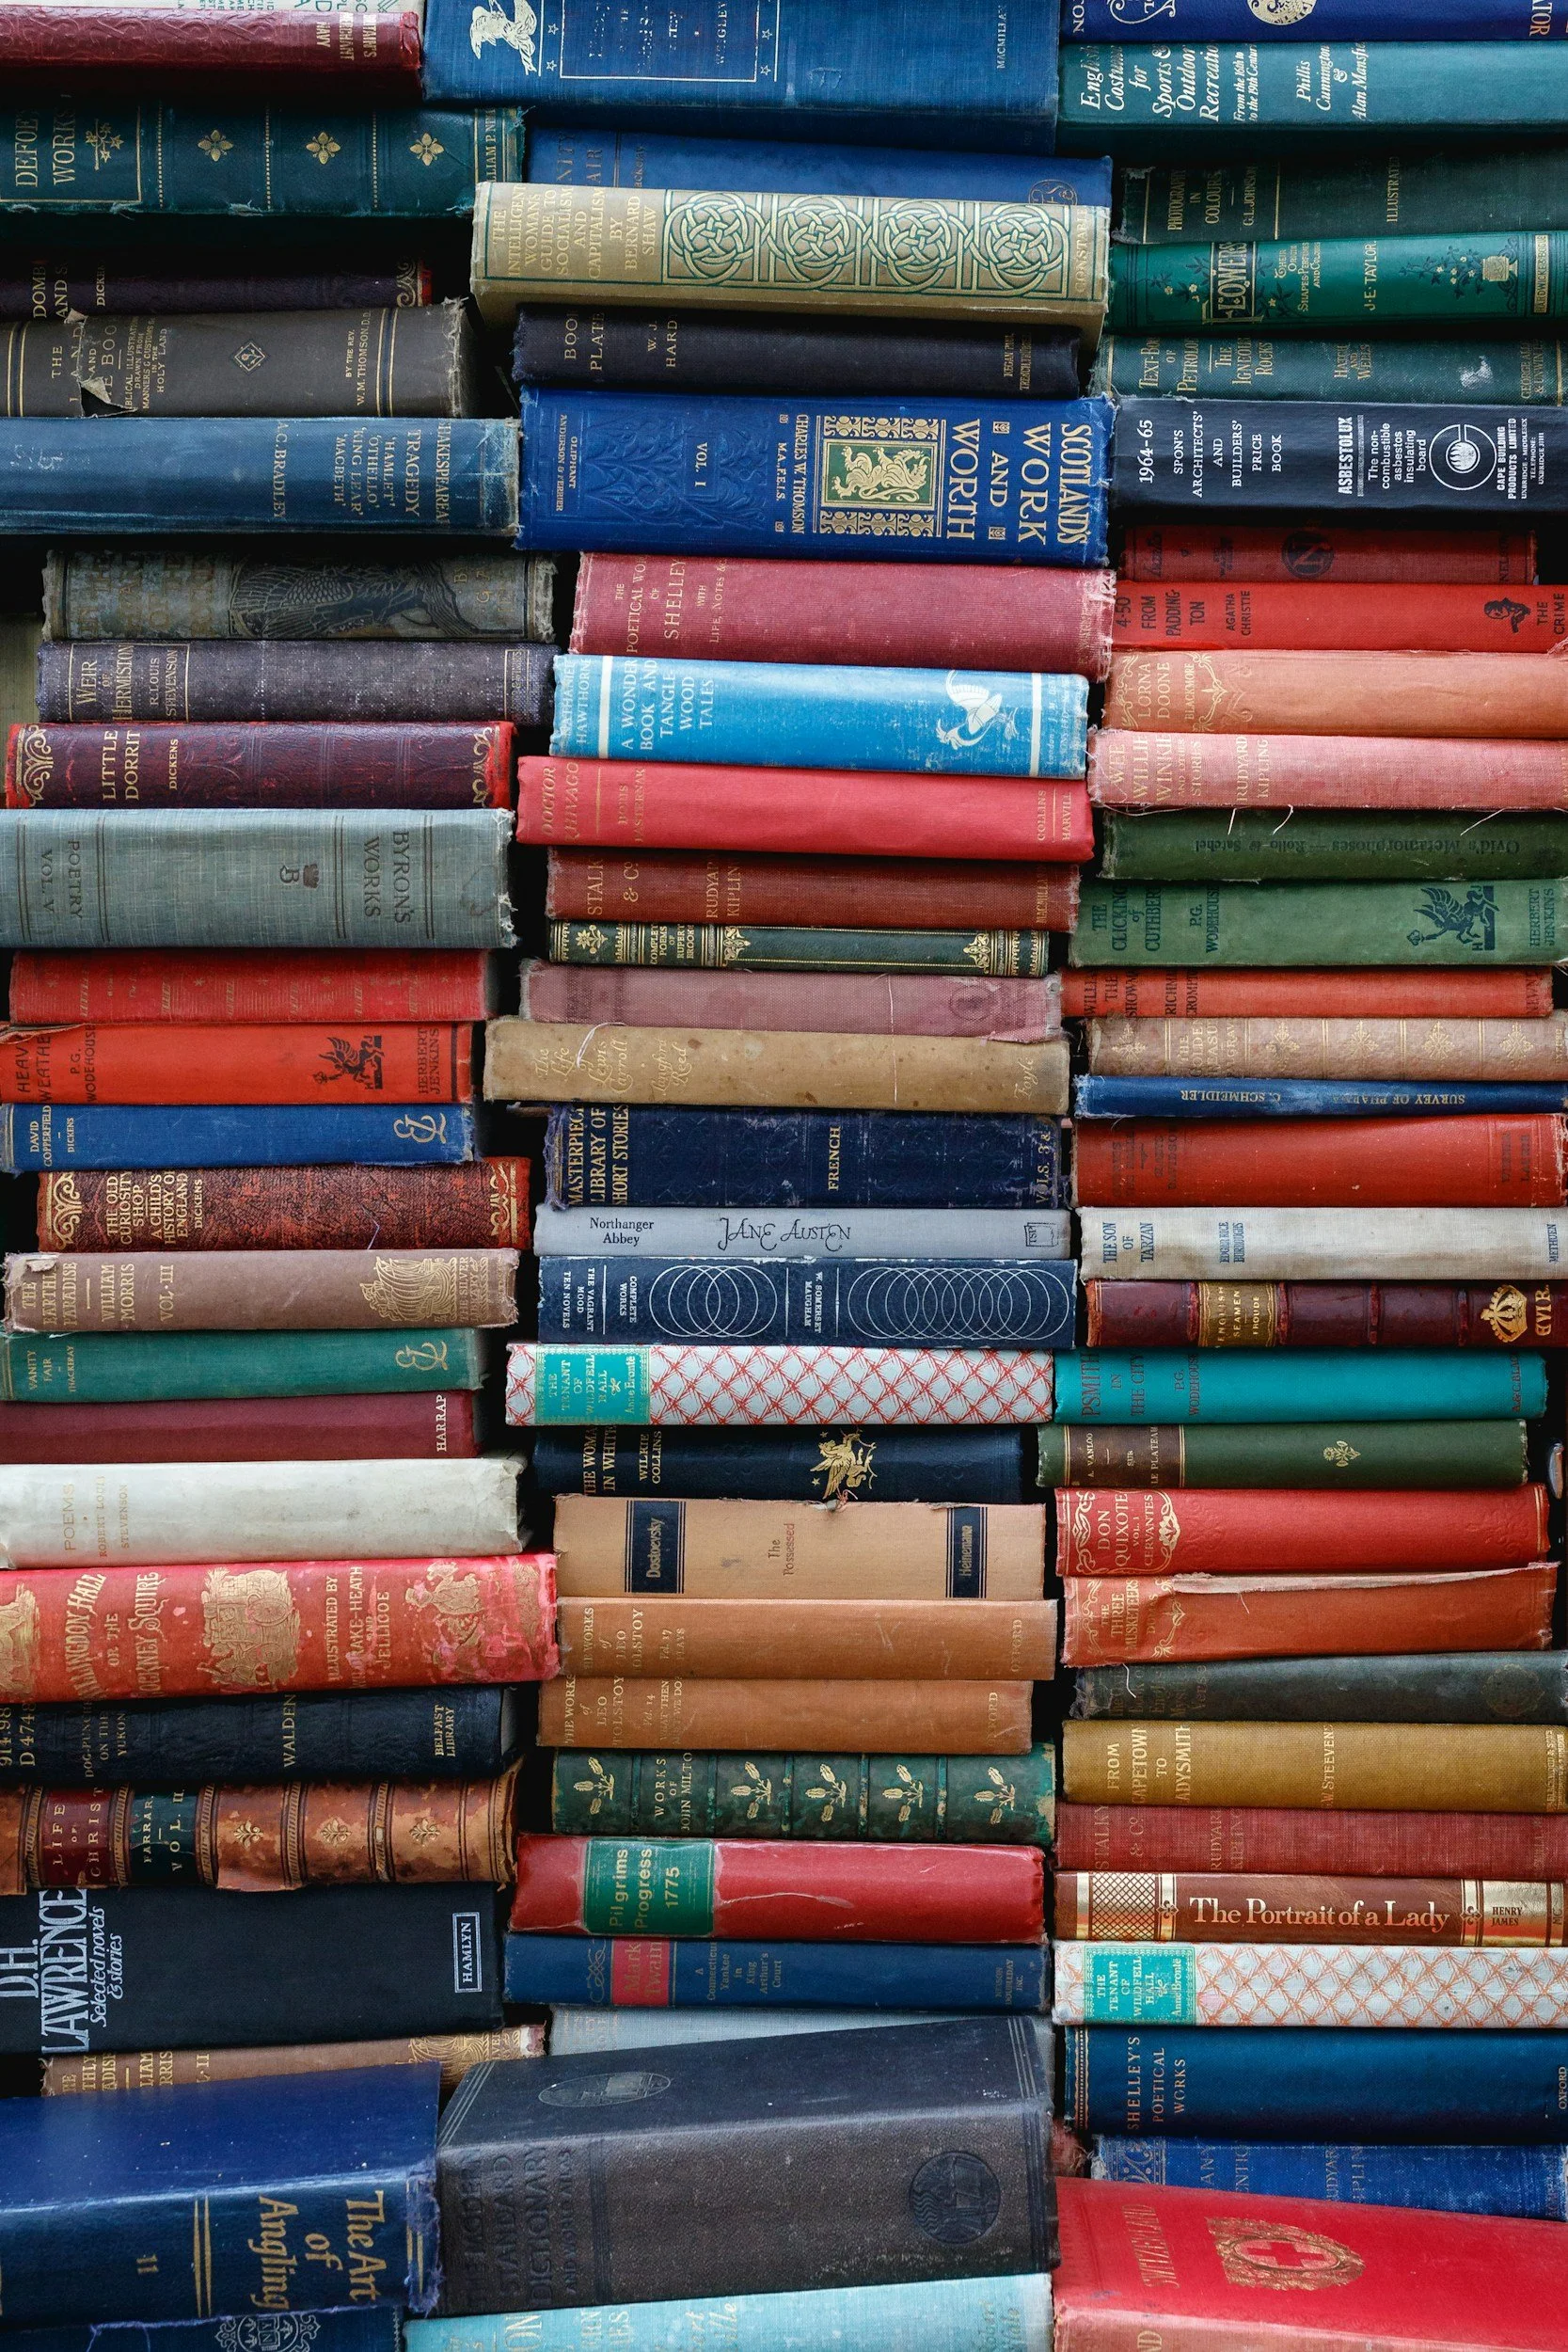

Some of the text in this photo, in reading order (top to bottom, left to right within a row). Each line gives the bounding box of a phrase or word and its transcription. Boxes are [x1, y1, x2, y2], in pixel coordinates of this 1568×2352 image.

[1130, 65, 1150, 90] for
[1153, 46, 1177, 118] Sports &
[1177, 46, 1199, 111] Outdoor
[1295, 60, 1313, 102] Phillis
[492, 210, 506, 245] THE
[541, 190, 557, 271] GUIDE TO
[574, 211, 587, 248] AND
[610, 217, 624, 240] BY
[626, 196, 641, 270] BERNARD
[641, 204, 657, 255] SHAW
[52, 345, 63, 378] THE
[157, 328, 167, 392] HOLY LAND
[347, 329, 356, 347] REV.
[1215, 347, 1233, 368] THE
[1256, 342, 1274, 375] ROCKS
[1335, 345, 1351, 378] HATCH
[1358, 344, 1372, 379] WELLS
[346, 368, 354, 377] BY
[404, 430, 420, 516] TRAGEDY
[569, 437, 578, 488] OLIPHANT
[792, 414, 809, 533] CHARLES W. THOMSON
[990, 451, 1008, 507] AND
[1138, 420, 1153, 484] 1964-65
[1173, 430, 1183, 474] SPON'S
[1193, 410, 1203, 498] ARCHITECTS'
[1212, 438, 1224, 468] AND
[1232, 420, 1243, 487] BUILDERS'
[1252, 434, 1263, 471] PRICE
[1272, 434, 1283, 472] BOOK
[1338, 417, 1354, 495] ASBESTOLUX
[1370, 430, 1381, 481] The non-
[1380, 422, 1391, 489] combustible
[1392, 431, 1403, 481] asbestos
[1404, 430, 1417, 484] insulating
[1417, 439, 1428, 471] board
[1497, 426, 1507, 490] CAPE BUILDING
[1508, 418, 1518, 499] PRODUCTS LIMITED
[946, 419, 980, 540] WORTH
[1018, 422, 1050, 545] WORK
[1056, 423, 1092, 544] SCOTLAND'S
[665, 557, 687, 640] SHELLEY
[1141, 596, 1157, 629] FROM
[1190, 601, 1206, 626] TON
[1226, 593, 1236, 631] AGATHA
[1240, 591, 1251, 636] CHRISTIE
[1536, 601, 1548, 627] THE
[1551, 593, 1565, 635] CRIME
[76, 660, 97, 704] WEIR
[102, 674, 111, 687] OF
[165, 649, 179, 717] STEVENSON
[621, 659, 638, 750] A WONDER
[640, 660, 657, 750] BOOK AND
[660, 669, 675, 739] TANGLE-
[680, 676, 696, 730] WOOD
[700, 679, 715, 730] TALES
[1137, 662, 1151, 718] LORNA
[1156, 662, 1171, 719] DOONE
[1184, 662, 1196, 721] BLACKMORE
[102, 730, 119, 801] LITTLE
[124, 729, 141, 801] DORRIT
[168, 739, 180, 789] DICKENS
[1234, 735, 1250, 802] RUDYARD
[1256, 739, 1271, 798] KIPLING
[541, 767, 557, 835] DOCTOR
[1037, 789, 1047, 842] COLLINS
[1061, 792, 1072, 841] HARVILL
[40, 850, 54, 913] VOL. V
[68, 840, 83, 919] POETRY
[364, 835, 381, 918] WORKS
[392, 831, 414, 924] BYRON'S
[29, 1120, 40, 1152] DAVID
[42, 1105, 54, 1167] COPPERFIELD
[67, 1117, 76, 1152] DICKENS
[591, 1108, 607, 1203] LIBRARY OF
[828, 1125, 842, 1190] FRENCH
[106, 1175, 119, 1236] THE OLD
[133, 1184, 145, 1227] SHOP
[149, 1174, 163, 1239] A CHILD'S
[176, 1173, 189, 1238] ENGLAND
[193, 1179, 203, 1229] DICKENS
[590, 1221, 655, 1231] Northanger
[603, 1235, 641, 1246] Abbey
[1102, 1222, 1117, 1263] THE SON
[1122, 1236, 1133, 1249] OF
[1140, 1222, 1154, 1263] TARZAN
[1546, 1223, 1560, 1263] METHUEN
[101, 1264, 117, 1322] WILLIAM
[119, 1263, 135, 1321] MORRIS
[1232, 1290, 1242, 1338] SEAMEN
[27, 1351, 38, 1391] VANITY
[43, 1358, 53, 1382] FAIR
[436, 1394, 448, 1452] HARRAP
[1085, 1433, 1094, 1466] VANLOO
[639, 1434, 650, 1481] WILKIE
[651, 1430, 663, 1484] COLLINS
[645, 1517, 663, 1578] Dostoevsky
[768, 1539, 781, 1559] The
[782, 1522, 795, 1576] Possessed
[958, 1525, 974, 1577] Heinemann
[1096, 1510, 1112, 1551] DON
[1113, 1493, 1130, 1567] QUIXOTE
[1143, 1494, 1155, 1566] CERVANTES
[325, 1575, 340, 1681] ILLUSTRATED BY
[375, 1591, 390, 1669] JELLICOE
[1110, 1593, 1126, 1638] THREE
[283, 1693, 297, 1768] WALDEN
[435, 1705, 445, 1756] BELFAST
[445, 1708, 456, 1756] LIBRARY
[609, 1849, 629, 1928] Pilgrims
[634, 1848, 654, 1929] Progress
[664, 1867, 680, 1908] 1775
[1189, 1897, 1450, 1932] The Portrait of a Lady
[1492, 1906, 1523, 1916] HENRY
[1492, 1917, 1519, 1927] JAMES
[39, 1888, 89, 2053] LAWRENCE
[89, 1906, 107, 2027] Selected novels
[106, 1932, 123, 2000] & stories
[460, 1921, 473, 1983] HAMLYN
[1096, 1975, 1106, 1998] THE
[1108, 1961, 1118, 2011] TENANT
[1133, 1956, 1143, 2016] WILDFELL
[1145, 1972, 1155, 2004] HALL
[1126, 2036, 1142, 2130] SHELLEY'S
[1152, 2047, 1165, 2122] POETICAL
[1173, 2058, 1186, 2114] WORKS
[1557, 2066, 1567, 2110] OXFORD
[247, 2195, 300, 2309] Angling
[306, 2233, 343, 2271] of
[345, 2191, 386, 2300] The Art
